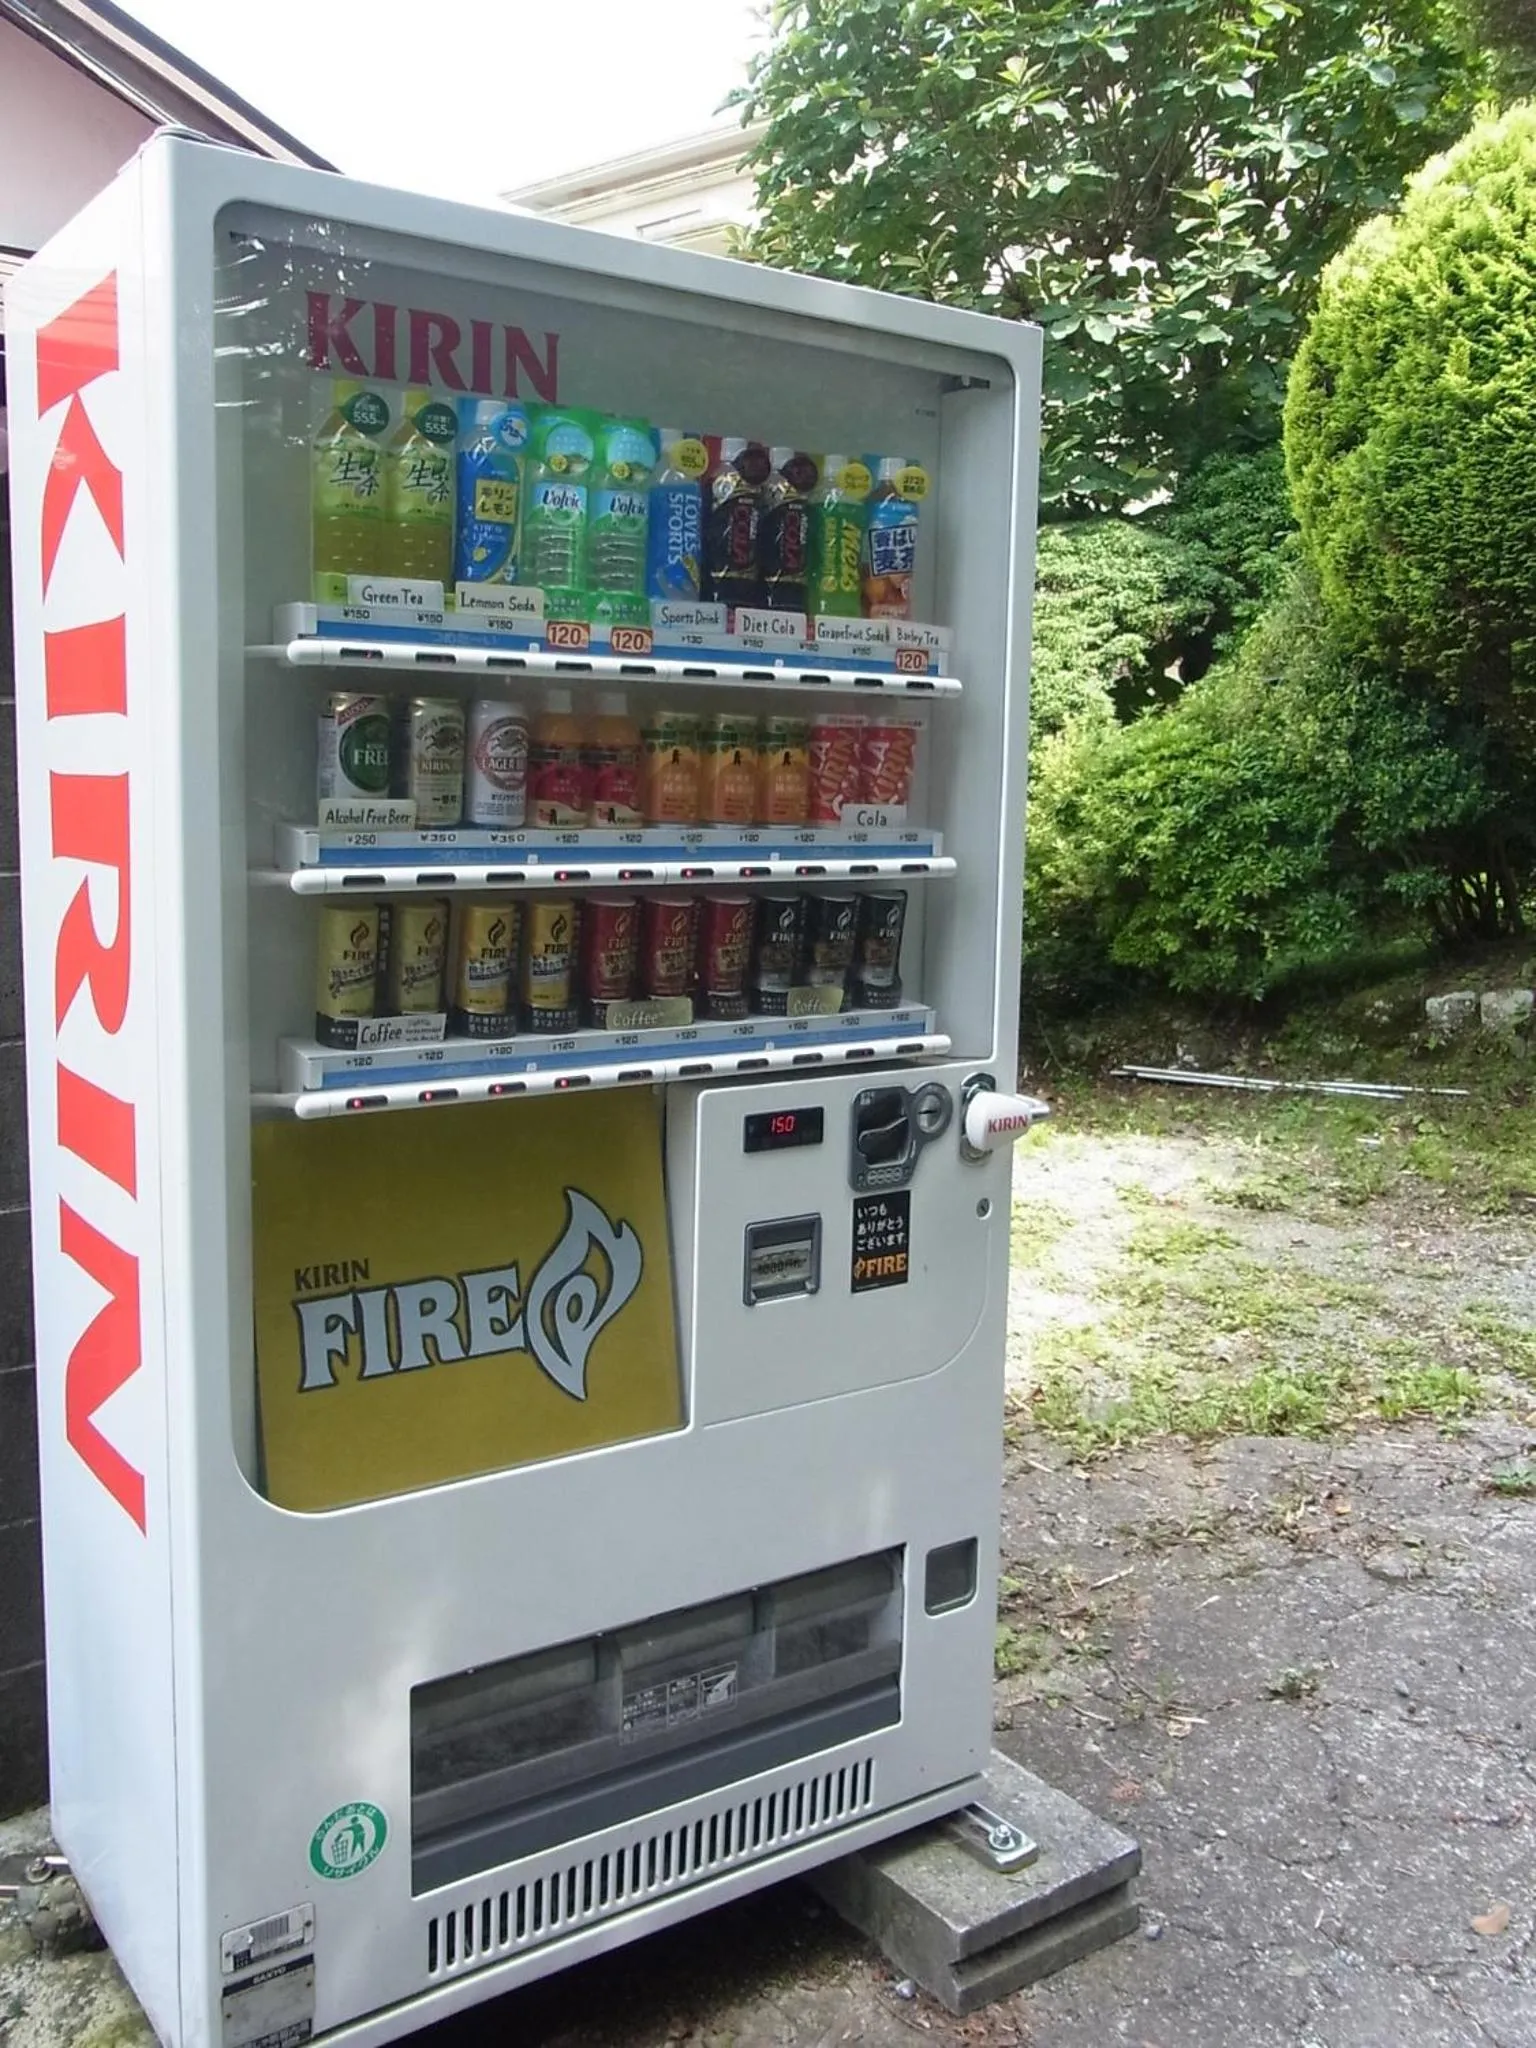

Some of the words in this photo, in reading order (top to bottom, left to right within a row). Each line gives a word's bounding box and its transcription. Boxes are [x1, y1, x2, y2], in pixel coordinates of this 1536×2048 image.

[306, 290, 560, 403] KIRIN
[543, 488, 580, 509] Volvic
[610, 495, 648, 515] Volvic
[668, 492, 684, 565] SPORTS
[684, 493, 700, 552] LOVES
[362, 585, 399, 604] Green
[401, 588, 423, 605] Tea
[508, 596, 536, 612] Soda
[661, 605, 694, 629] Sports
[695, 609, 720, 625] Drink
[743, 615, 769, 633] Diet
[771, 618, 796, 635] Cola
[550, 627, 581, 645] 120
[614, 631, 645, 650] 120
[924, 631, 939, 646] Tea
[899, 654, 922, 670] 120
[325, 807, 365, 824] Alcohol
[366, 807, 388, 824] Free
[388, 807, 413, 824] Beer
[856, 810, 887, 827] Cola
[36, 268, 147, 1538] KIRIN
[612, 1010, 659, 1027] Coffee
[361, 1022, 402, 1044] Coffee
[771, 1115, 796, 1134] 150
[988, 1114, 1029, 1133] KIRIN
[857, 1202, 887, 1218] いつも
[857, 1216, 904, 1236] ありがとう
[295, 1258, 370, 1291] KIRIN
[866, 1252, 907, 1278] FIRE
[292, 1260, 530, 1393] FIRE
